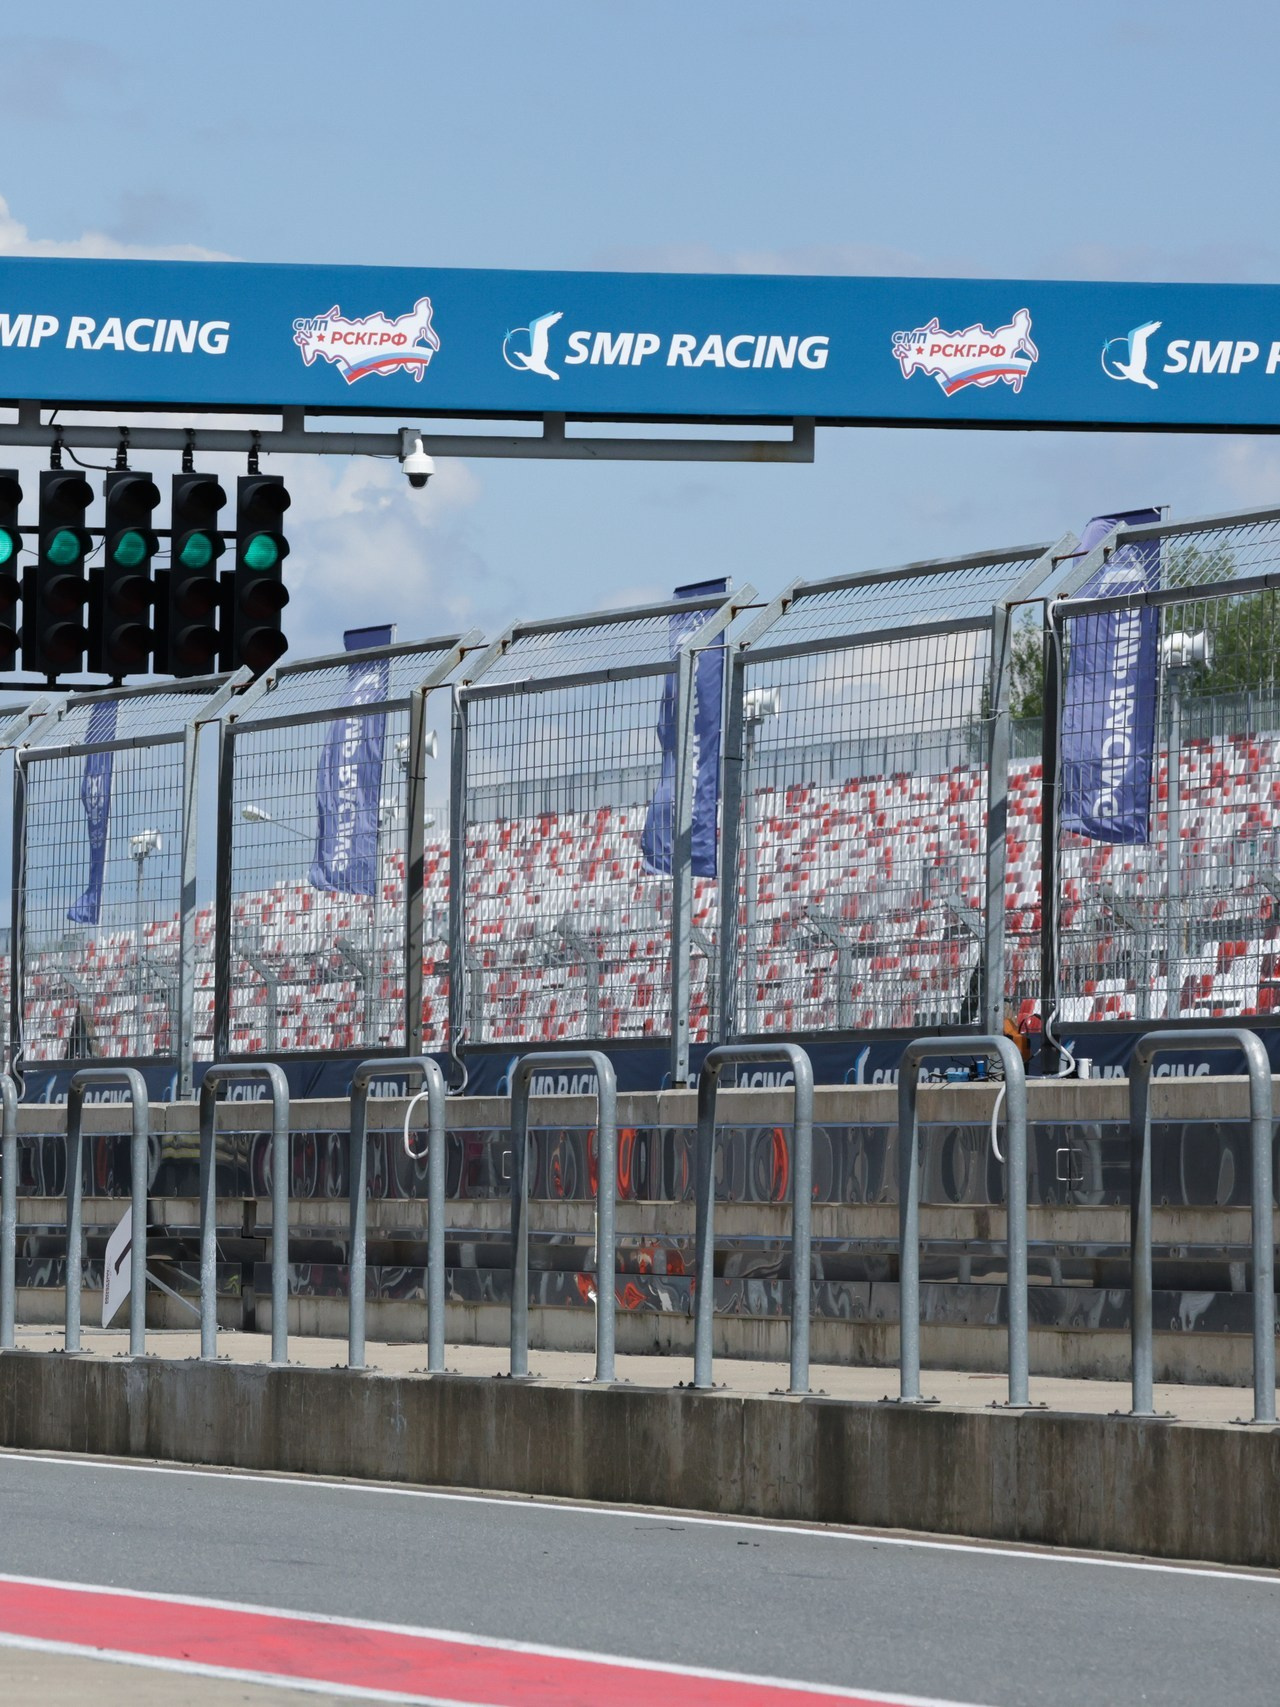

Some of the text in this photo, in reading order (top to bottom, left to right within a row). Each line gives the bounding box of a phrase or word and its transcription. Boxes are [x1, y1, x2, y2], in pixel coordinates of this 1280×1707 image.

[293, 318, 329, 331] СМП
[65, 316, 230, 355] RACING
[330, 331, 408, 346] РСКГ.РФ
[892, 332, 928, 344] СМП
[564, 331, 829, 369] SMP RACING
[929, 344, 1006, 358] РСКГ.РФ
[1163, 339, 1259, 374] SMP
